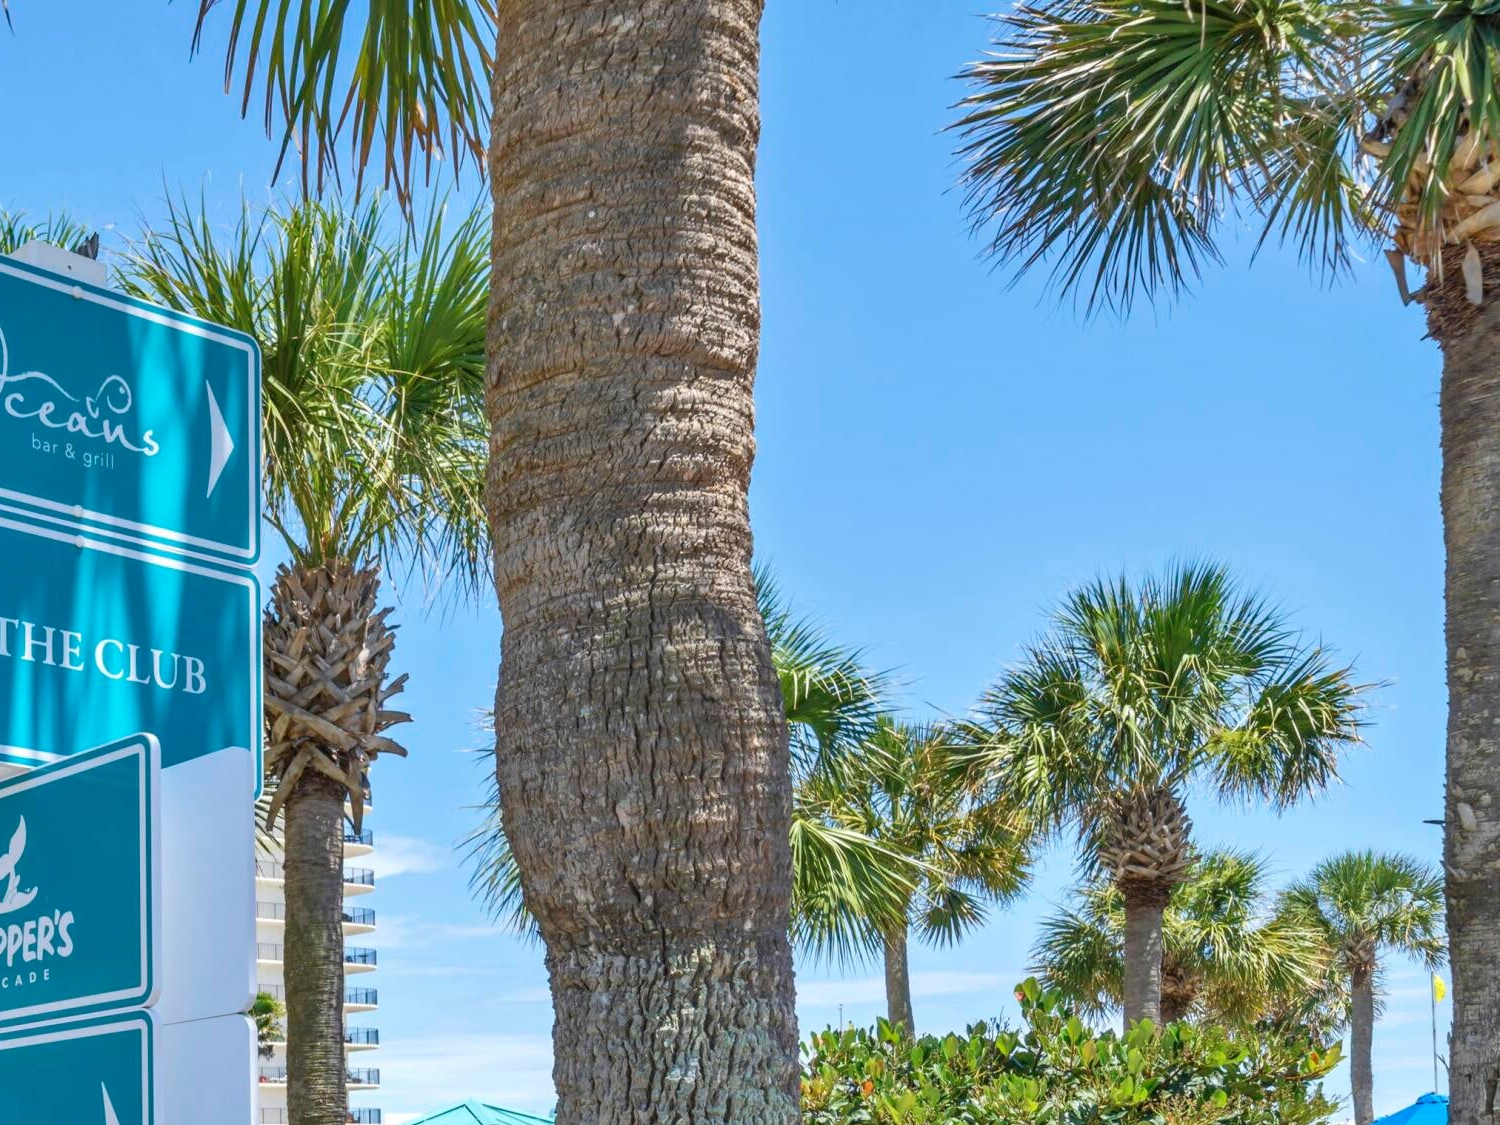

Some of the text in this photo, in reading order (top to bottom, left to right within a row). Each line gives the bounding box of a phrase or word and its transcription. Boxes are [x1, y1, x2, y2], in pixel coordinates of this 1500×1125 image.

[32, 433, 114, 469] bar & grill
[94, 638, 207, 695] CLUB
